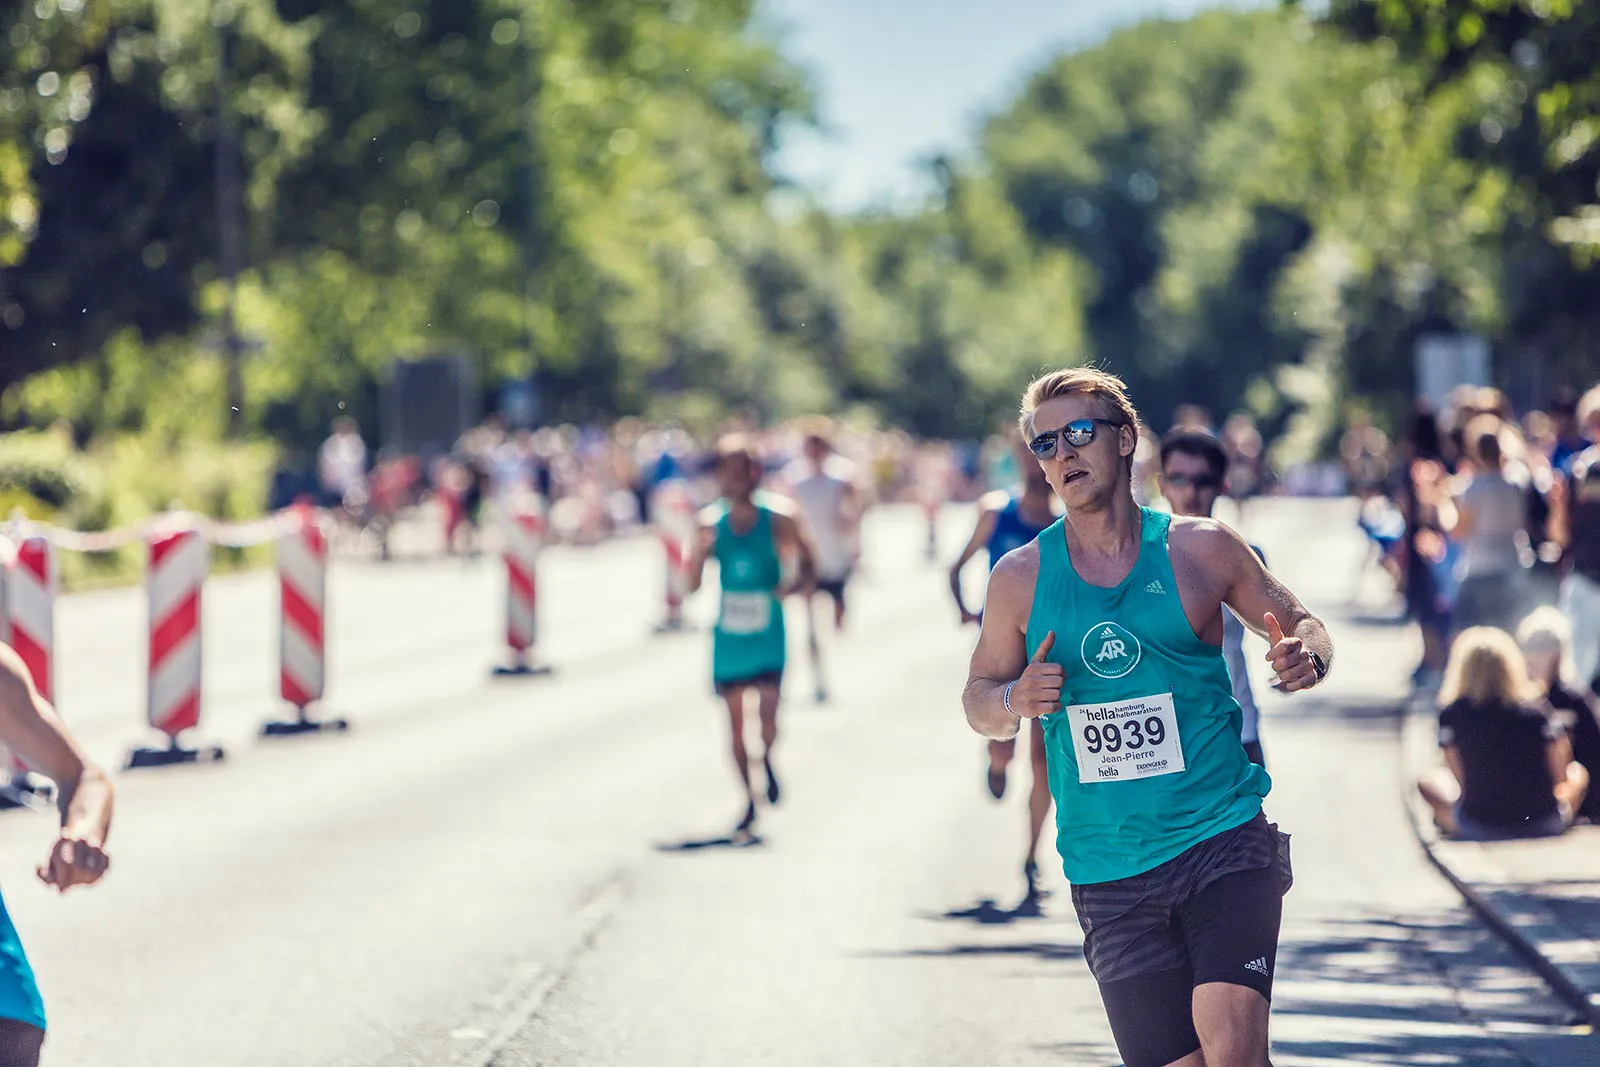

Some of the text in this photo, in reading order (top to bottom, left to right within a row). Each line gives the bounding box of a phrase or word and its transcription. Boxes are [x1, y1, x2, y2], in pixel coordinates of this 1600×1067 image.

[1096, 639, 1128, 662] AR
[1086, 708, 1116, 721] hella
[1115, 703, 1145, 713] hamburg
[1115, 706, 1162, 719] halbmarathon
[1083, 716, 1165, 753] 9939
[1101, 750, 1155, 764] Jean-Pierre
[1098, 767, 1119, 777] hella
[1244, 963, 1269, 976] adidas
